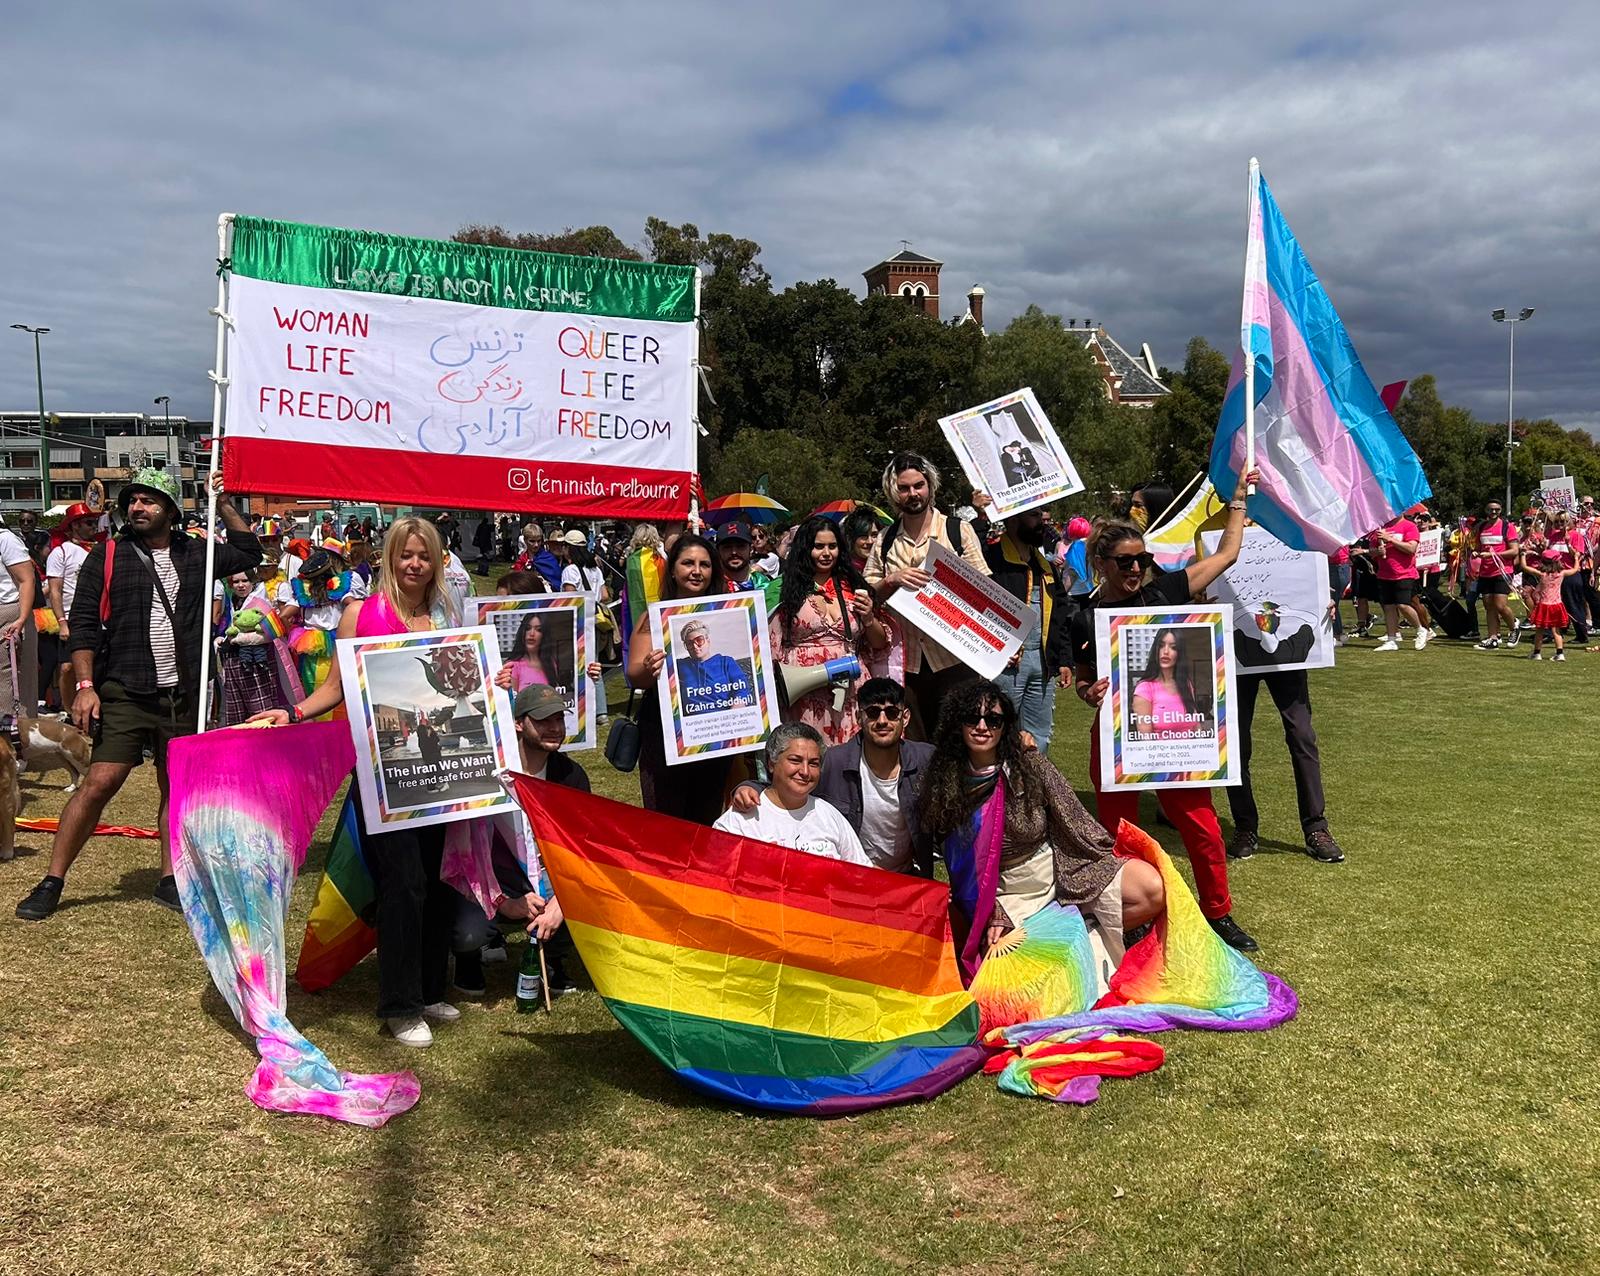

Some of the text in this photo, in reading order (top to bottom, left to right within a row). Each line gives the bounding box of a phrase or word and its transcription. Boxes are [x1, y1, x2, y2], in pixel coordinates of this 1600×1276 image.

[334, 265, 401, 288] LOVE
[412, 274, 436, 293] IS
[444, 277, 492, 297] NOT
[504, 285, 515, 300] A
[274, 306, 368, 338] WOMAN
[287, 344, 356, 375] LIFE
[430, 331, 524, 367] ترنس
[558, 327, 660, 364] QUEER
[438, 364, 522, 403] زندگی
[560, 368, 634, 400] LIFE
[260, 387, 390, 424] FREEDOM
[418, 402, 532, 454] آزادی
[558, 408, 670, 440] FREEDOM
[996, 472, 1059, 498] The Iran We Want
[973, 581, 992, 596] PEOPLE
[917, 594, 993, 654] HOMOSEXUALITY WHICH THEY
[919, 607, 978, 653] CLAIM DOES NOT EXIST
[959, 613, 970, 623] THE
[969, 621, 996, 644] COUNTRY
[976, 615, 988, 626] THIS
[993, 628, 1009, 642] HOW
[993, 616, 1011, 632] AVOID
[686, 679, 746, 698] Free Sareh
[686, 694, 753, 714] (Zahra Seddiqi)
[1130, 712, 1204, 724] Free Elham
[1162, 728, 1214, 739] Choobdar)
[386, 754, 494, 778] The Iran We Want
[398, 768, 486, 788] free and safe for all
